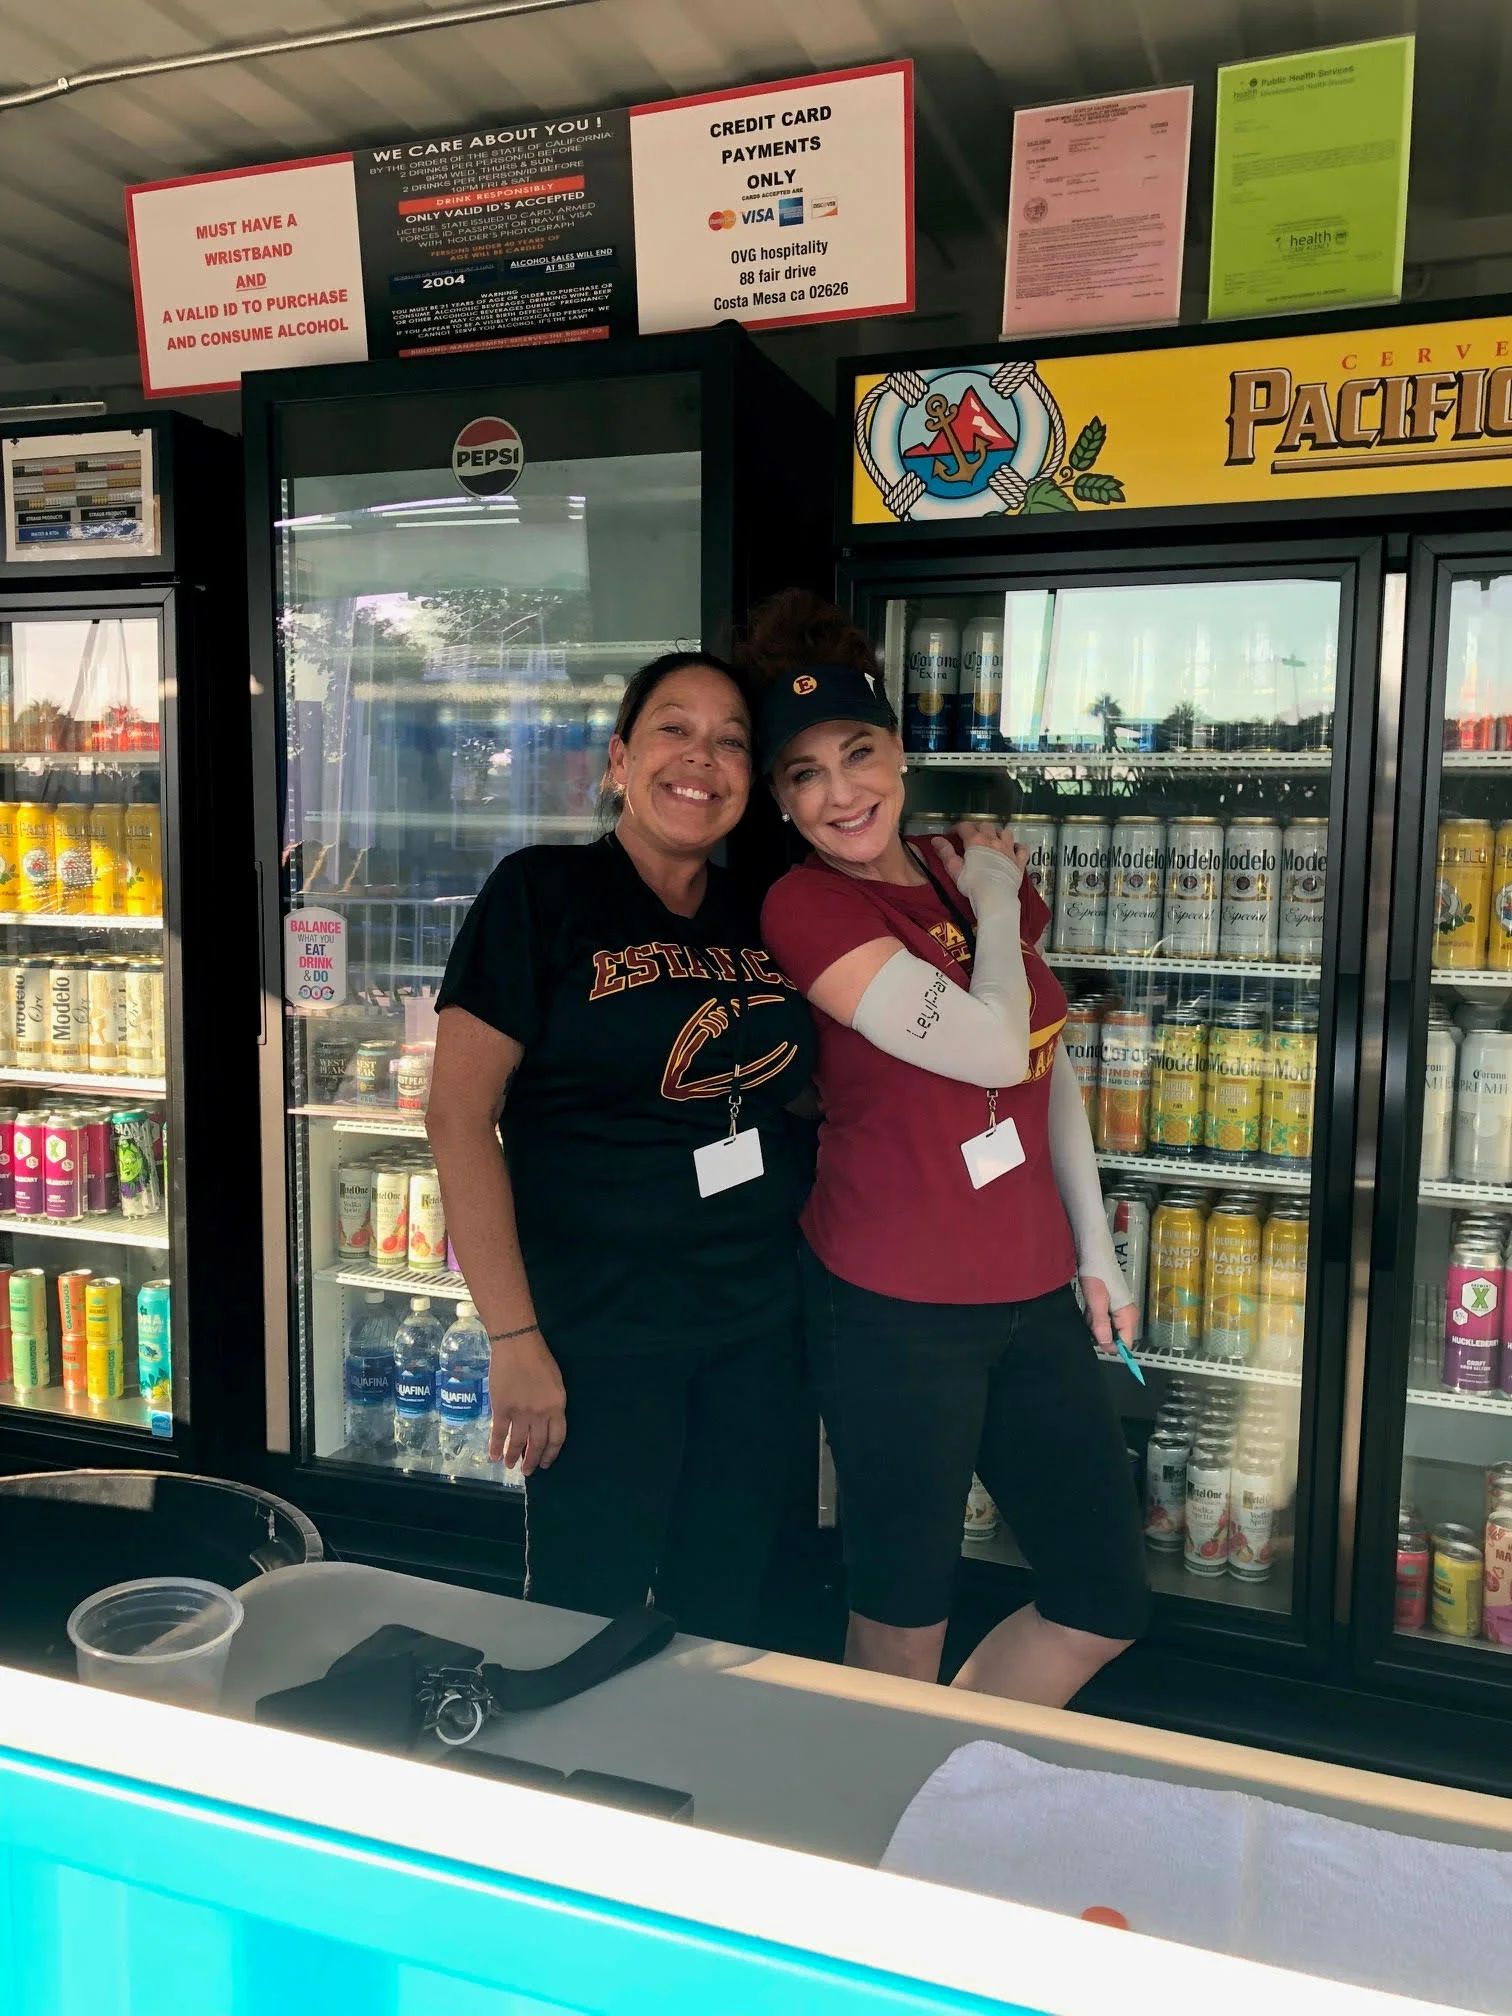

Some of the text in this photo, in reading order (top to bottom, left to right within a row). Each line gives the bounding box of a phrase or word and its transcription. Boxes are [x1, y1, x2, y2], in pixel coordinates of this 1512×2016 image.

[710, 105, 831, 138] CREDIT CARD
[373, 116, 601, 163] WE CARE ABOUT YOU !
[722, 136, 821, 164] PAYMENTS
[369, 167, 383, 175] BY
[384, 163, 406, 172] THE
[409, 157, 446, 169] ORDER
[449, 154, 463, 162] OF
[468, 150, 488, 159] THE
[491, 145, 523, 156] STATE
[527, 142, 540, 150] OF
[409, 165, 448, 176] DRINKS
[451, 161, 472, 170] PER
[476, 151, 534, 166] PERSON/ID
[537, 144, 581, 157] BEFORE
[411, 180, 450, 191] DRINKS
[453, 176, 474, 185] PER
[478, 167, 537, 181] PERSON/ID
[540, 160, 584, 172] BEFORE
[425, 172, 447, 181] 9PM
[480, 162, 517, 173] THURS
[747, 169, 796, 189] ONLY
[436, 183, 553, 205] DRINK RESPONSIBLY
[451, 183, 478, 193] 10PM
[762, 190, 790, 199] ACCEPTED
[405, 191, 584, 223] ONLY VALID ID'S ACCEPTED
[441, 220, 468, 229] STATE
[470, 215, 504, 225] ISSUED
[557, 202, 595, 213] ARMED
[742, 208, 774, 224] VISA
[196, 213, 297, 239] MUST HAVE A
[400, 231, 439, 242] FORCES
[458, 222, 508, 234] PASSPORT
[511, 219, 526, 227] OR
[530, 214, 564, 224] TRAVEL
[569, 210, 592, 219] VISA
[419, 221, 574, 247] WITH HOLDER'S PHOTOGRAPH
[1290, 230, 1332, 249] health
[205, 242, 293, 266] WRISTBAND
[510, 248, 612, 268] ALCOHOL SALES WILL END
[731, 240, 828, 264] OVG hospitality
[557, 261, 575, 270] 9:30
[740, 265, 816, 285] 88 fair drive
[236, 272, 266, 290] AND
[422, 274, 465, 288] 2004
[162, 289, 347, 323] A VALID ID TO PURCHASE
[714, 282, 848, 310] Costa Mesa ca 02626
[167, 317, 348, 350] AND CONSUME ALCOHOL
[457, 448, 519, 467] PEPSI
[920, 668, 947, 679] Extra
[796, 677, 814, 693] E
[1166, 847, 1220, 870] Modelo
[290, 920, 341, 934] BALANCE
[298, 934, 334, 943] WHAT YOU
[299, 956, 333, 969] DRINK
[589, 942, 797, 1001] ESTANC
[304, 970, 328, 982] & DO
[53, 976, 70, 1041] Modelo
[1473, 1069, 1507, 1080] Corona
[1215, 1264, 1252, 1276] CART
